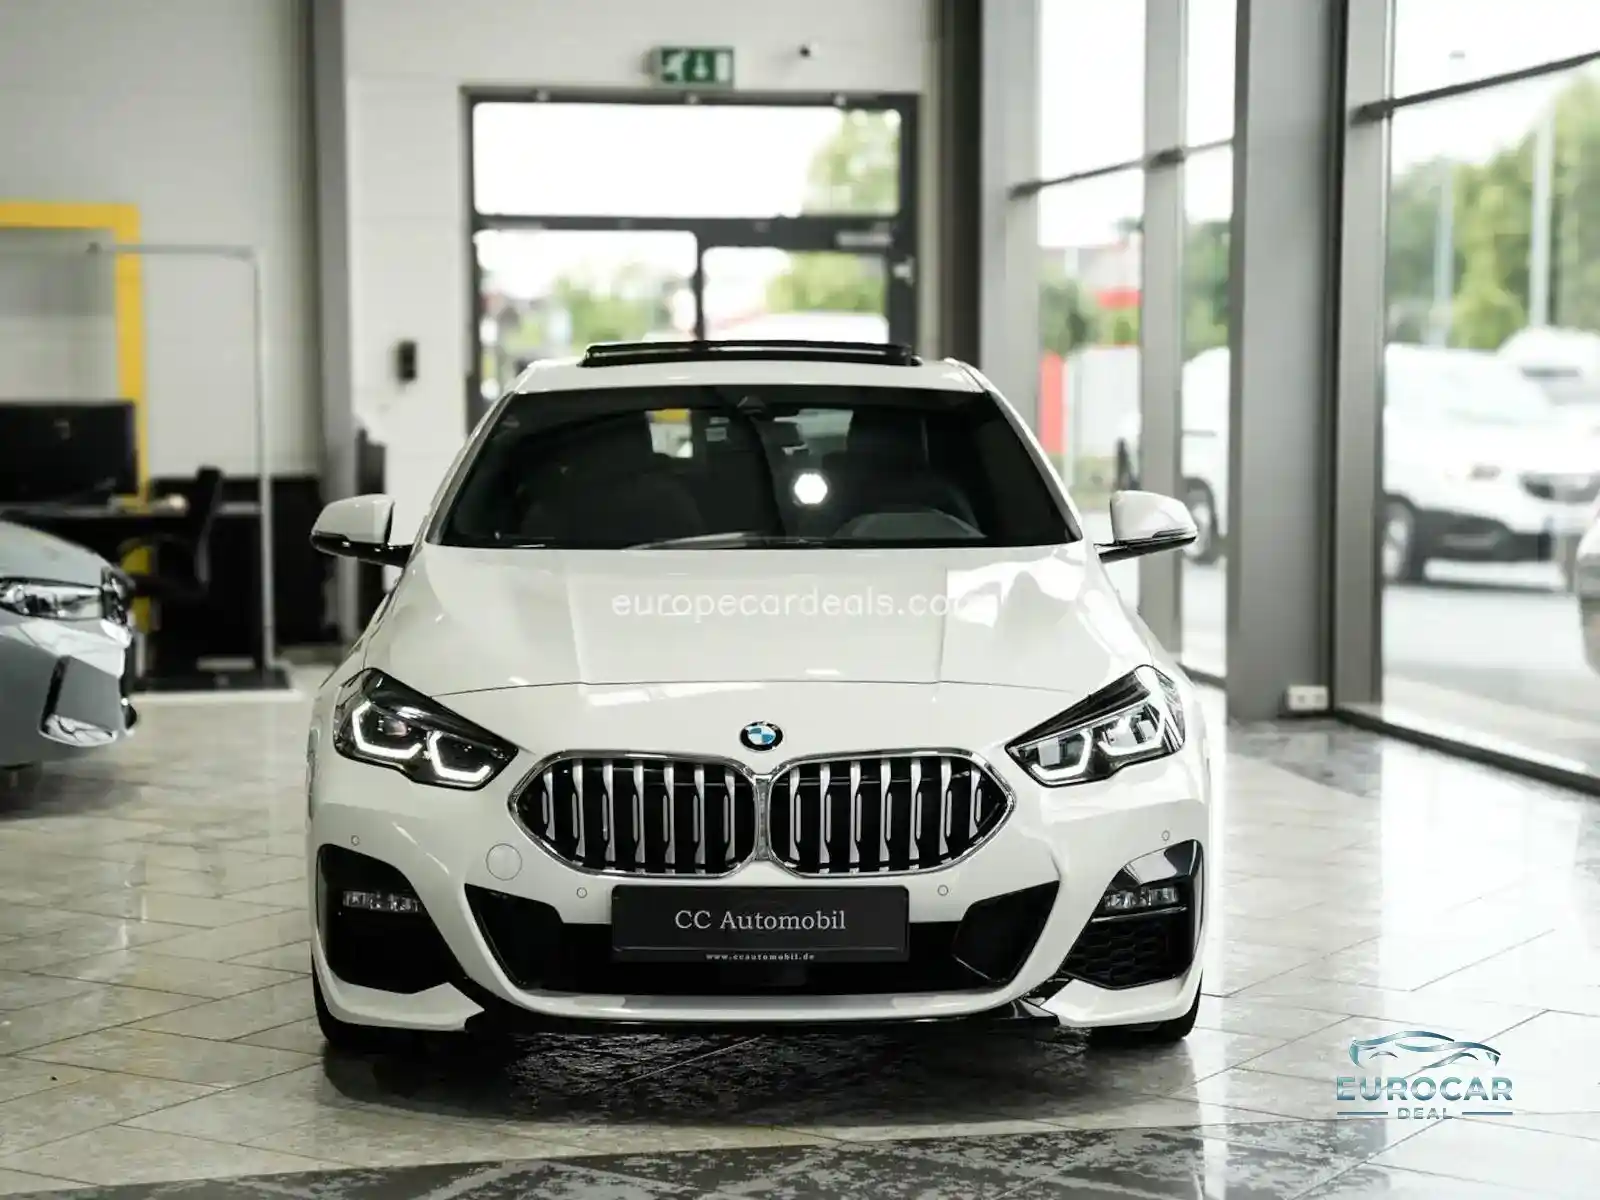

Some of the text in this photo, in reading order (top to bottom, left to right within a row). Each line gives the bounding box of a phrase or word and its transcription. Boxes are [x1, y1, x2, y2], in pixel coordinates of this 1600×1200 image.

[674, 910, 847, 930] CC Automobil
[705, 952, 815, 961] www.ccautomobil.de
